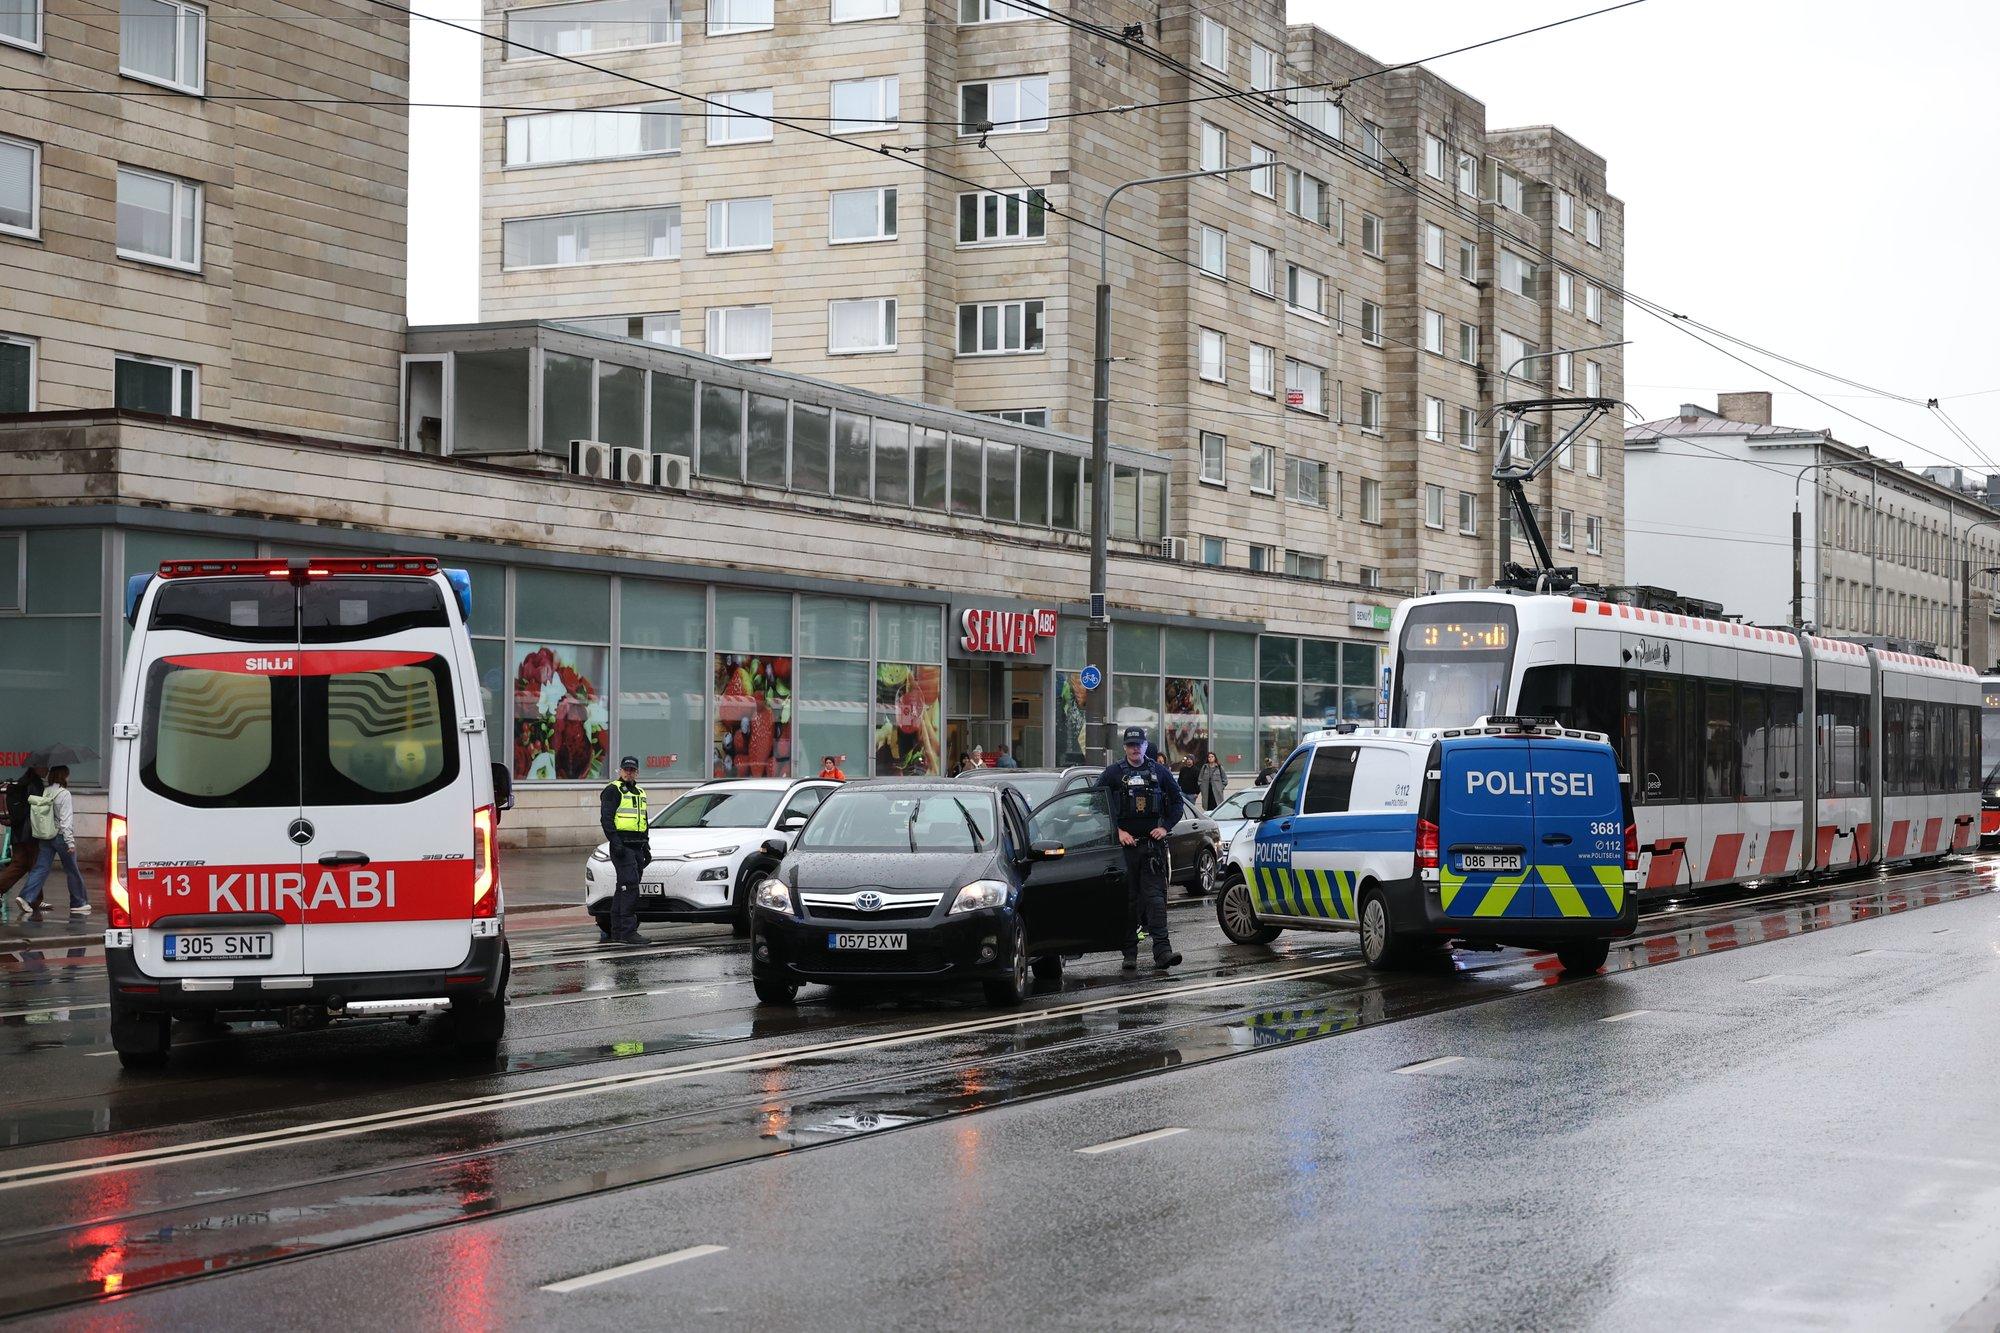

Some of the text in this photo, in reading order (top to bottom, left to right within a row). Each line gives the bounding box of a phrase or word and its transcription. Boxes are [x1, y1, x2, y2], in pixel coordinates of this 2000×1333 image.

[963, 609, 1054, 655] SELVER ABC
[0, 751, 32, 768] SELV
[1400, 784, 1410, 796] 112
[1466, 771, 1594, 796] POLITSEI
[1590, 822, 1621, 835] 3681
[1255, 842, 1291, 863] POLITSEI
[1605, 841, 1621, 851] 112
[1464, 855, 1486, 867] 086
[1492, 856, 1518, 867] PPR
[1578, 852, 1621, 860] www.POLITSEI.ee
[162, 870, 395, 912] 13 KIIRABI
[641, 884, 660, 894] VLC
[180, 936, 214, 955] 305
[224, 935, 266, 954] SNT
[839, 935, 865, 949] 057
[867, 935, 904, 949] BXW
